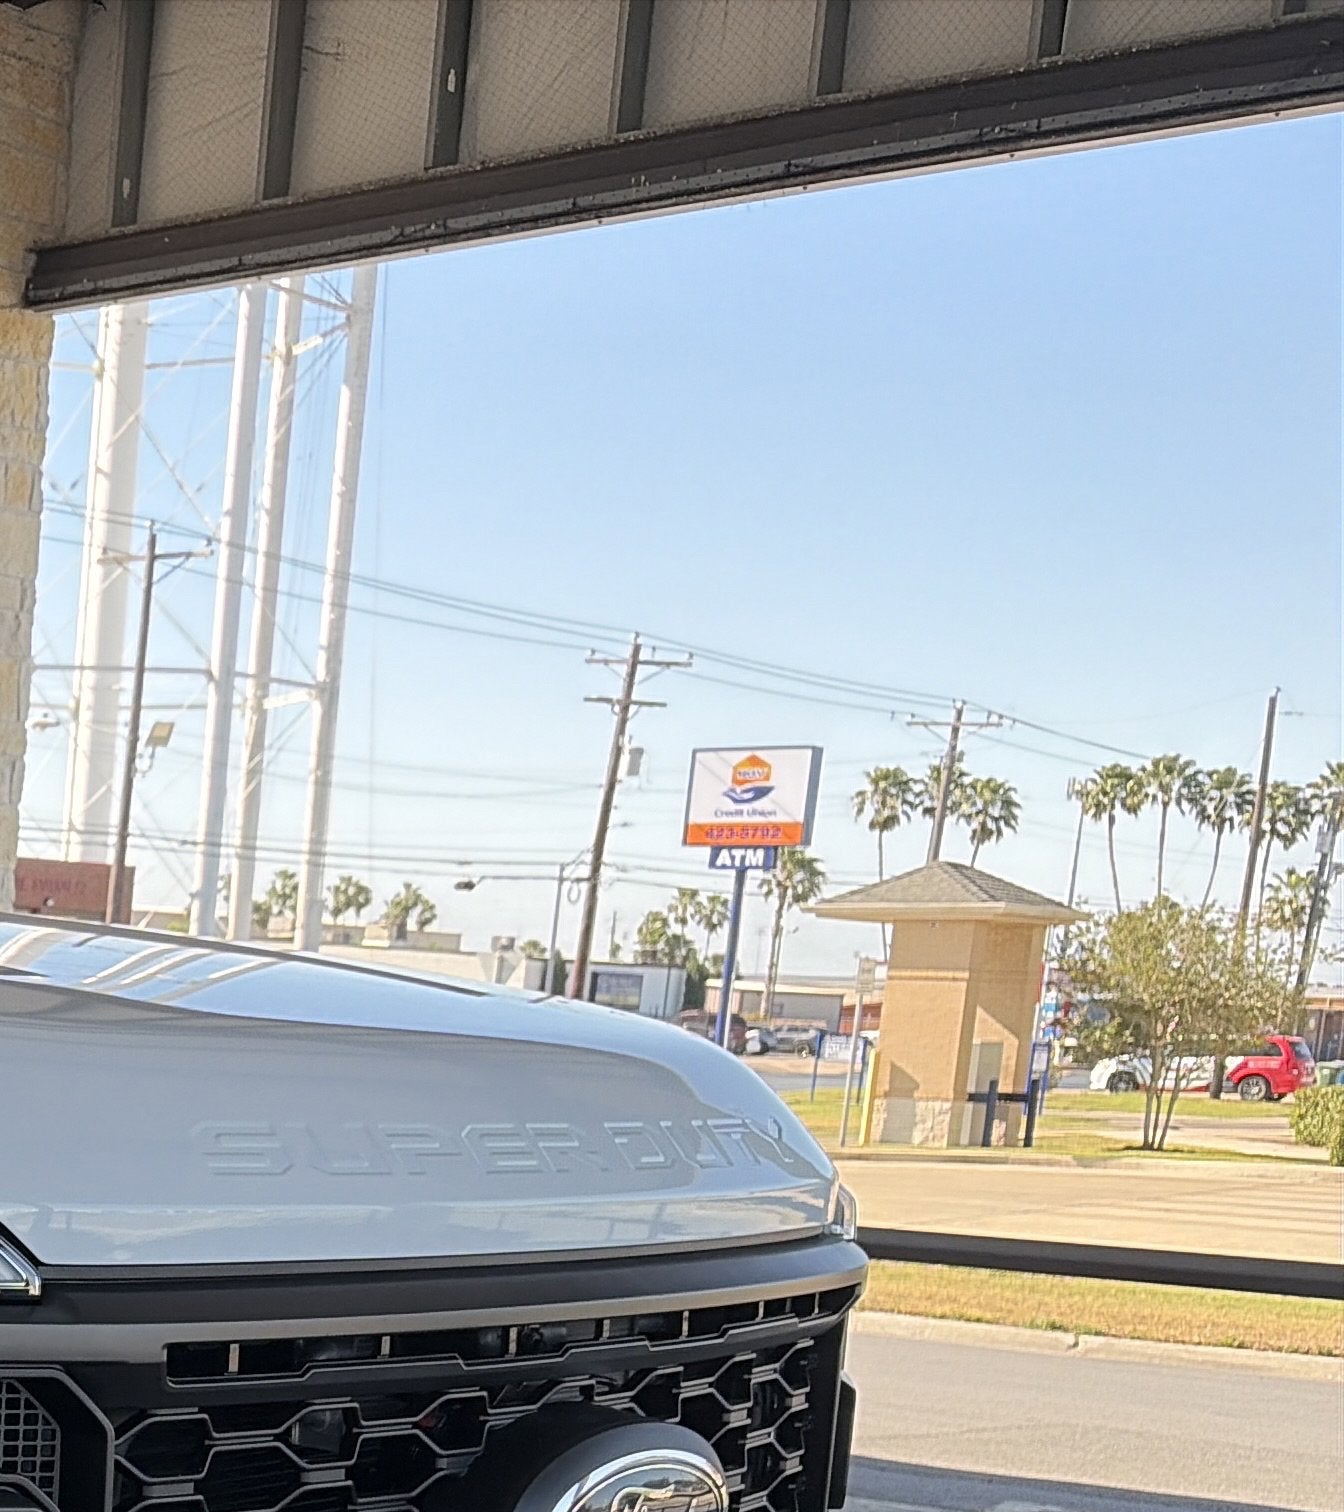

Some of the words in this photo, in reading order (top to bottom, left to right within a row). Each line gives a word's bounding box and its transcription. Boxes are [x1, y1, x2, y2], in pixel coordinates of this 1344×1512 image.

[715, 848, 764, 867] ATM
[191, 1119, 609, 1176] SUPER
[603, 1114, 795, 1171] DUTY
